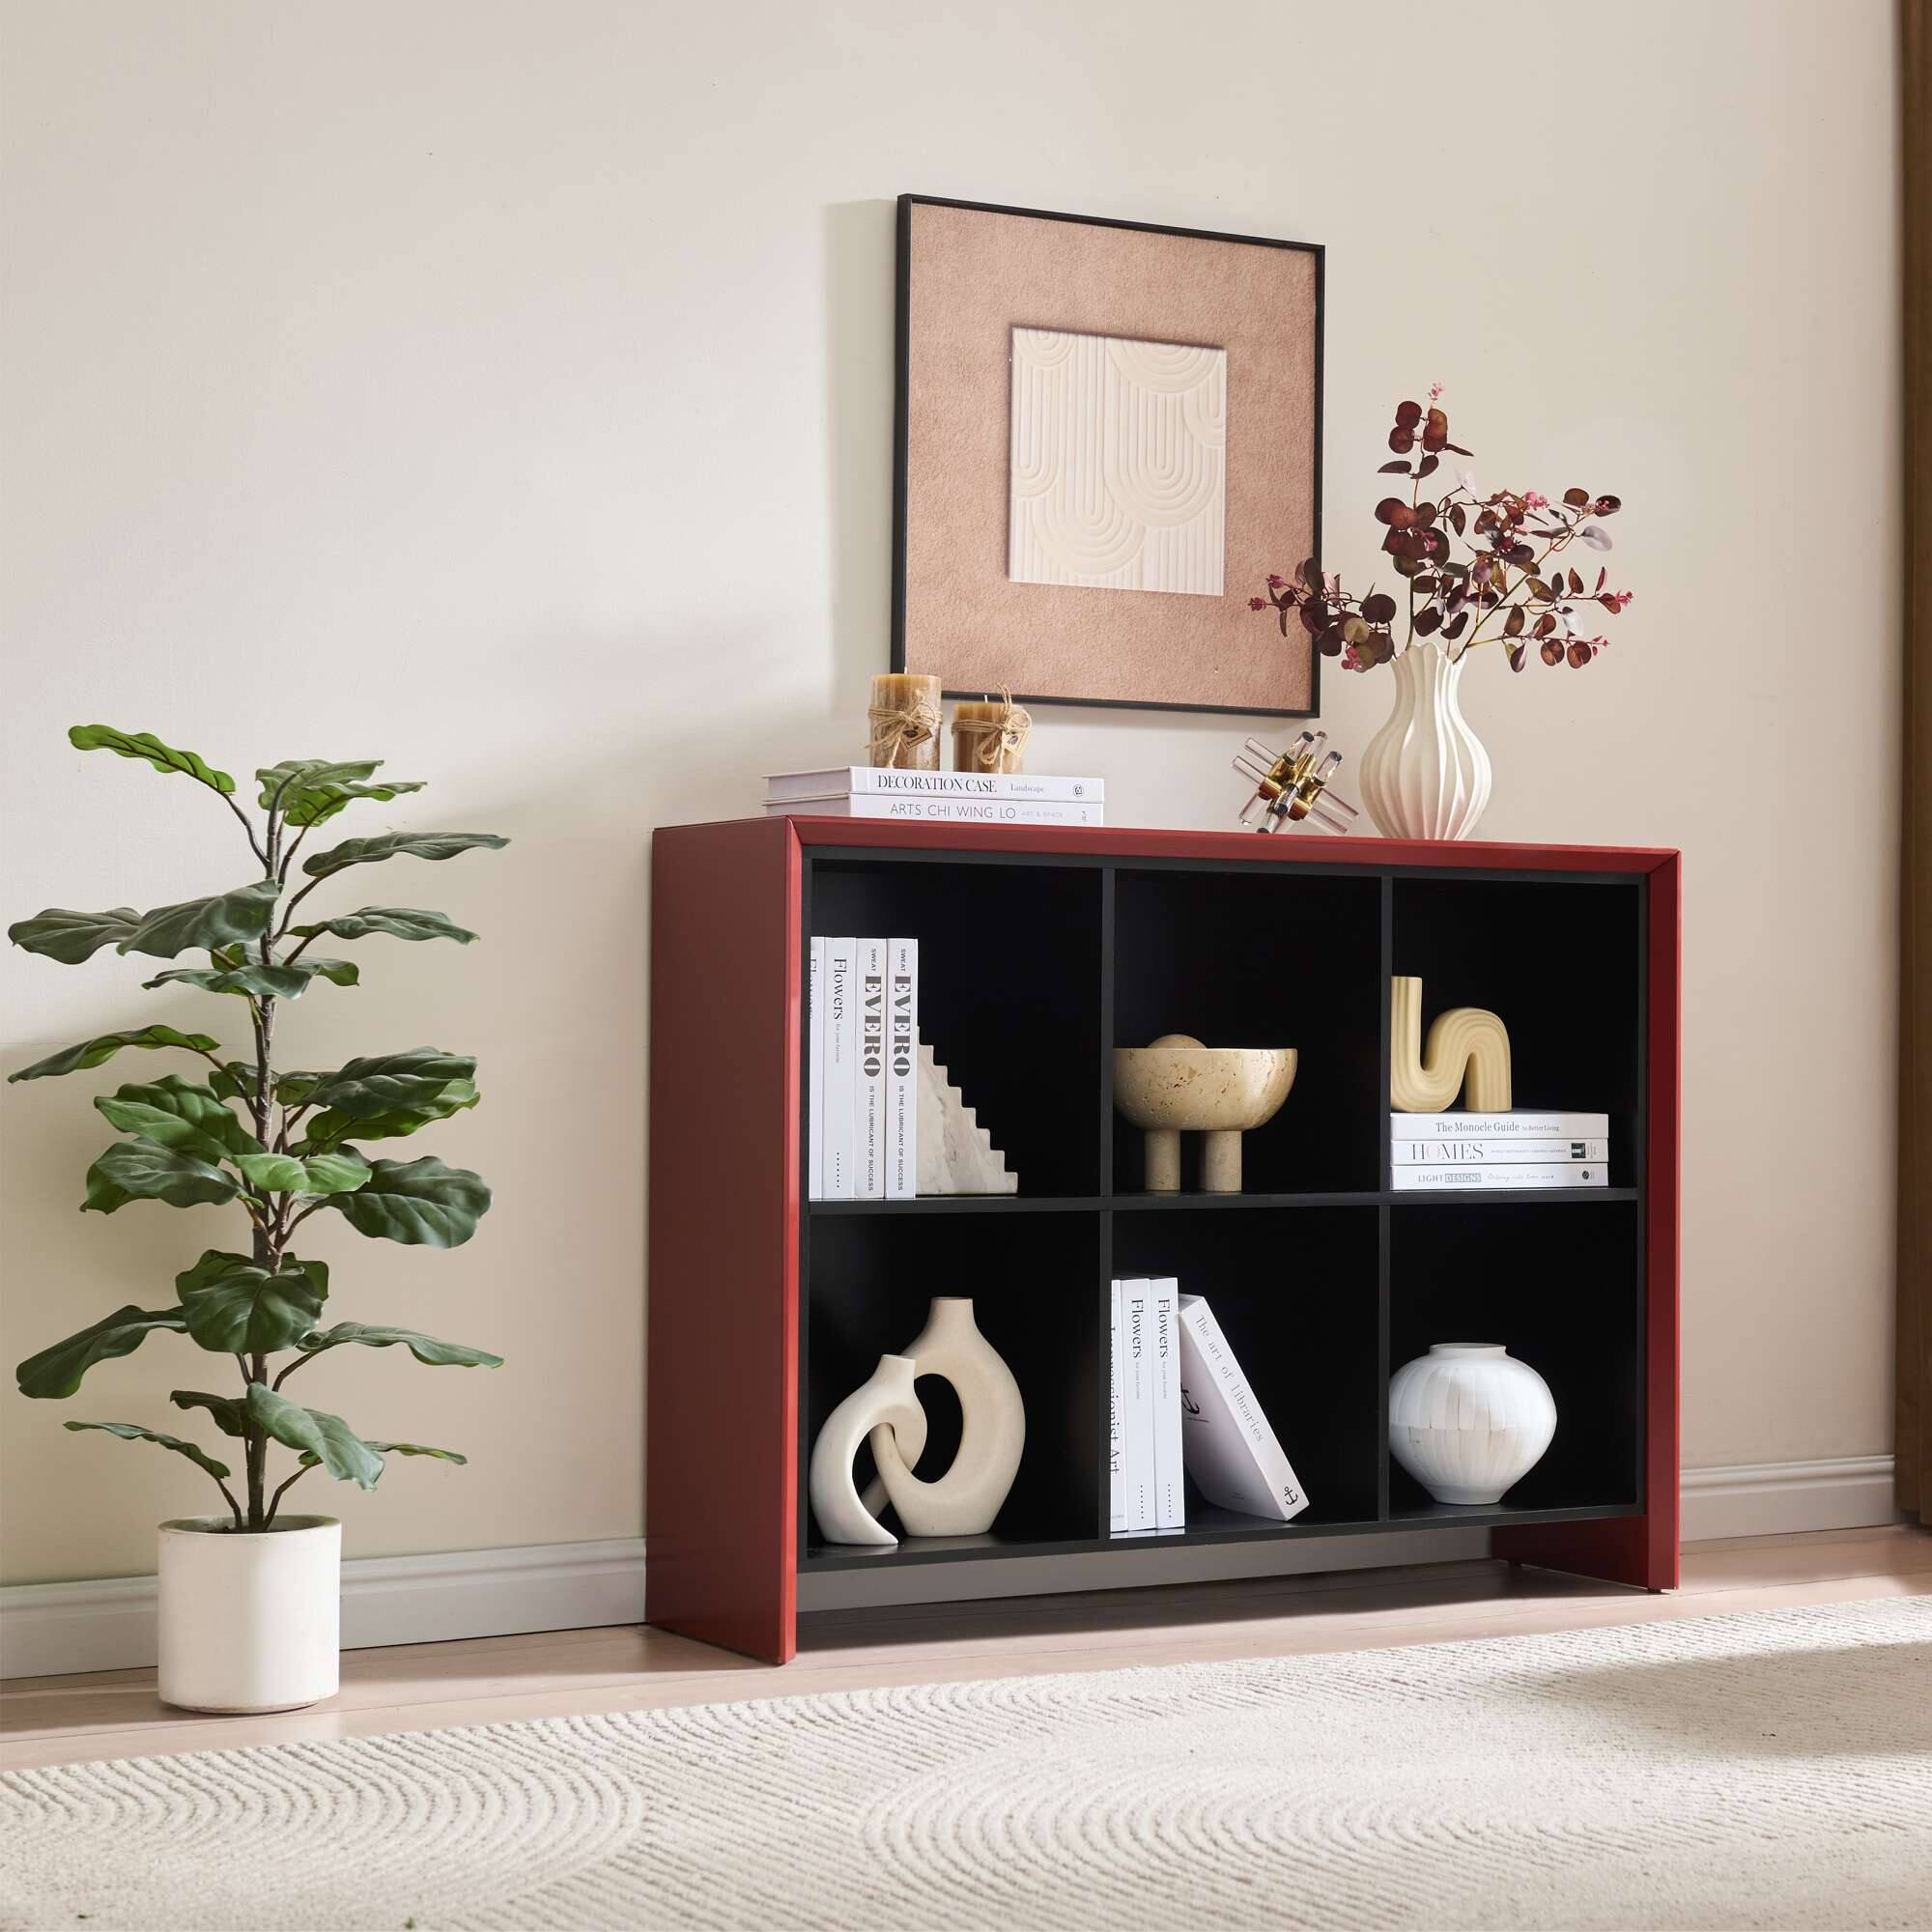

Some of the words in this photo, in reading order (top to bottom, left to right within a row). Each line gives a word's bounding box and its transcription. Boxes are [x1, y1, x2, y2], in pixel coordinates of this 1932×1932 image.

[878, 775, 963, 790] DECORATION
[965, 779, 997, 793] CASE
[890, 804, 922, 816] ARTS
[927, 805, 951, 817] CHI
[956, 806, 993, 819] WING
[1000, 807, 1016, 819] LO
[834, 958, 847, 1020] Flowers
[864, 976, 881, 1077] EVERO
[894, 976, 910, 1077] EVERO
[1435, 1122, 1453, 1132] The
[1455, 1122, 1492, 1132] Monocle
[1493, 1122, 1520, 1132] Guide
[868, 1149, 874, 1157] OF
[897, 1149, 903, 1157] OF
[1411, 1144, 1484, 1160] HOMES
[1418, 1174, 1443, 1182] LIGHT
[1445, 1174, 1481, 1182] DESIGNS
[1131, 1299, 1144, 1358] Flowers
[1158, 1298, 1170, 1357] Flowers
[1196, 1314, 1209, 1337] The
[1208, 1341, 1222, 1361] art
[1221, 1366, 1234, 1379] of
[1232, 1384, 1264, 1442] libraries
